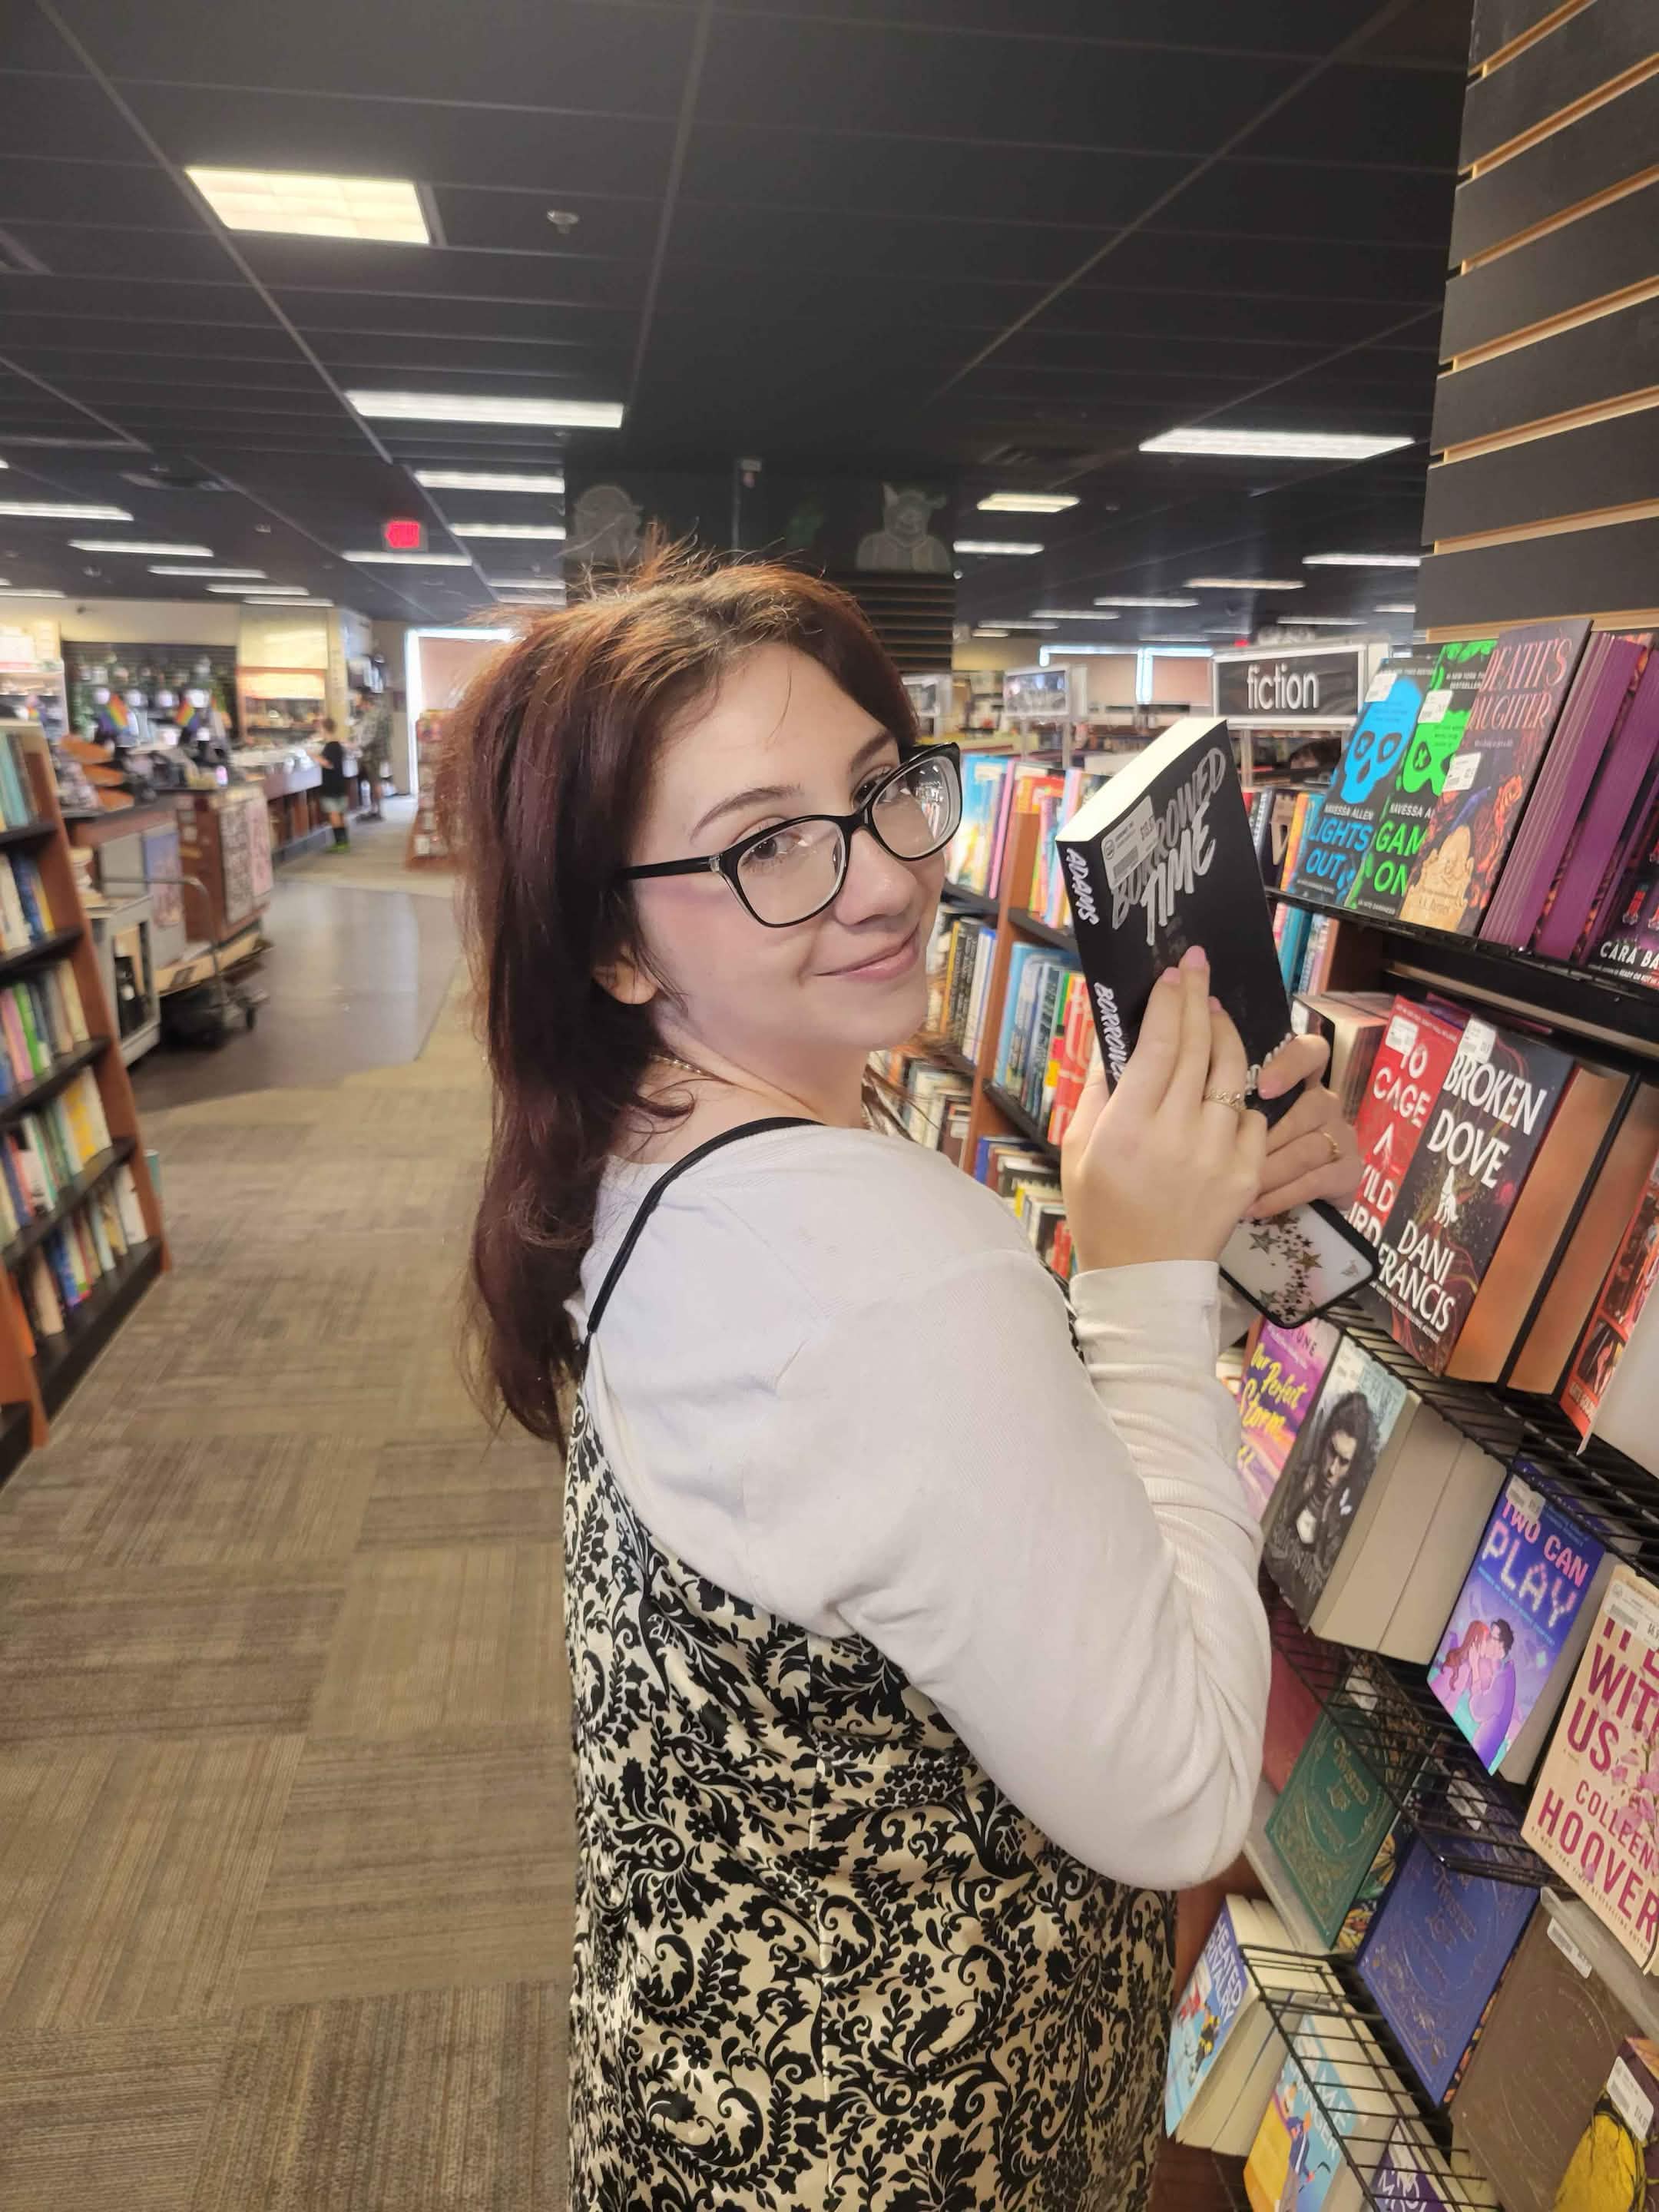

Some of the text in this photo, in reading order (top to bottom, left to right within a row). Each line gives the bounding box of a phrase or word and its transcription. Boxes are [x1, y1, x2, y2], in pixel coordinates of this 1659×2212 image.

[1247, 664, 1319, 710] fiction
[1308, 817, 1374, 853] LIGHTS
[1390, 803, 1422, 819] NAVESSA
[1066, 847, 1100, 925] ADAMS
[1140, 800, 1216, 946] TIME
[1306, 847, 1346, 881] OUT
[1373, 859, 1409, 898] ON
[1600, 941, 1637, 965] CARA
[1373, 1067, 1432, 1129] CAGE
[1442, 1051, 1547, 1135] BROKEN
[1426, 1108, 1511, 1188] DOVE
[1346, 1201, 1382, 1248] IRD
[1398, 1220, 1455, 1286] DANI
[1379, 1243, 1455, 1332] FRANCIS
[1250, 1343, 1272, 1370] Our
[1260, 1362, 1307, 1410] Perfect
[1240, 1378, 1286, 1432] Storm
[1482, 1519, 1577, 1628] PLAY
[1544, 1535, 1589, 1587] CAN
[1568, 1697, 1619, 1772] US
[1575, 1780, 1654, 1872] COLLEEN
[1538, 1788, 1659, 1943] HOOVER
[1216, 1912, 1243, 2007] HEATED
